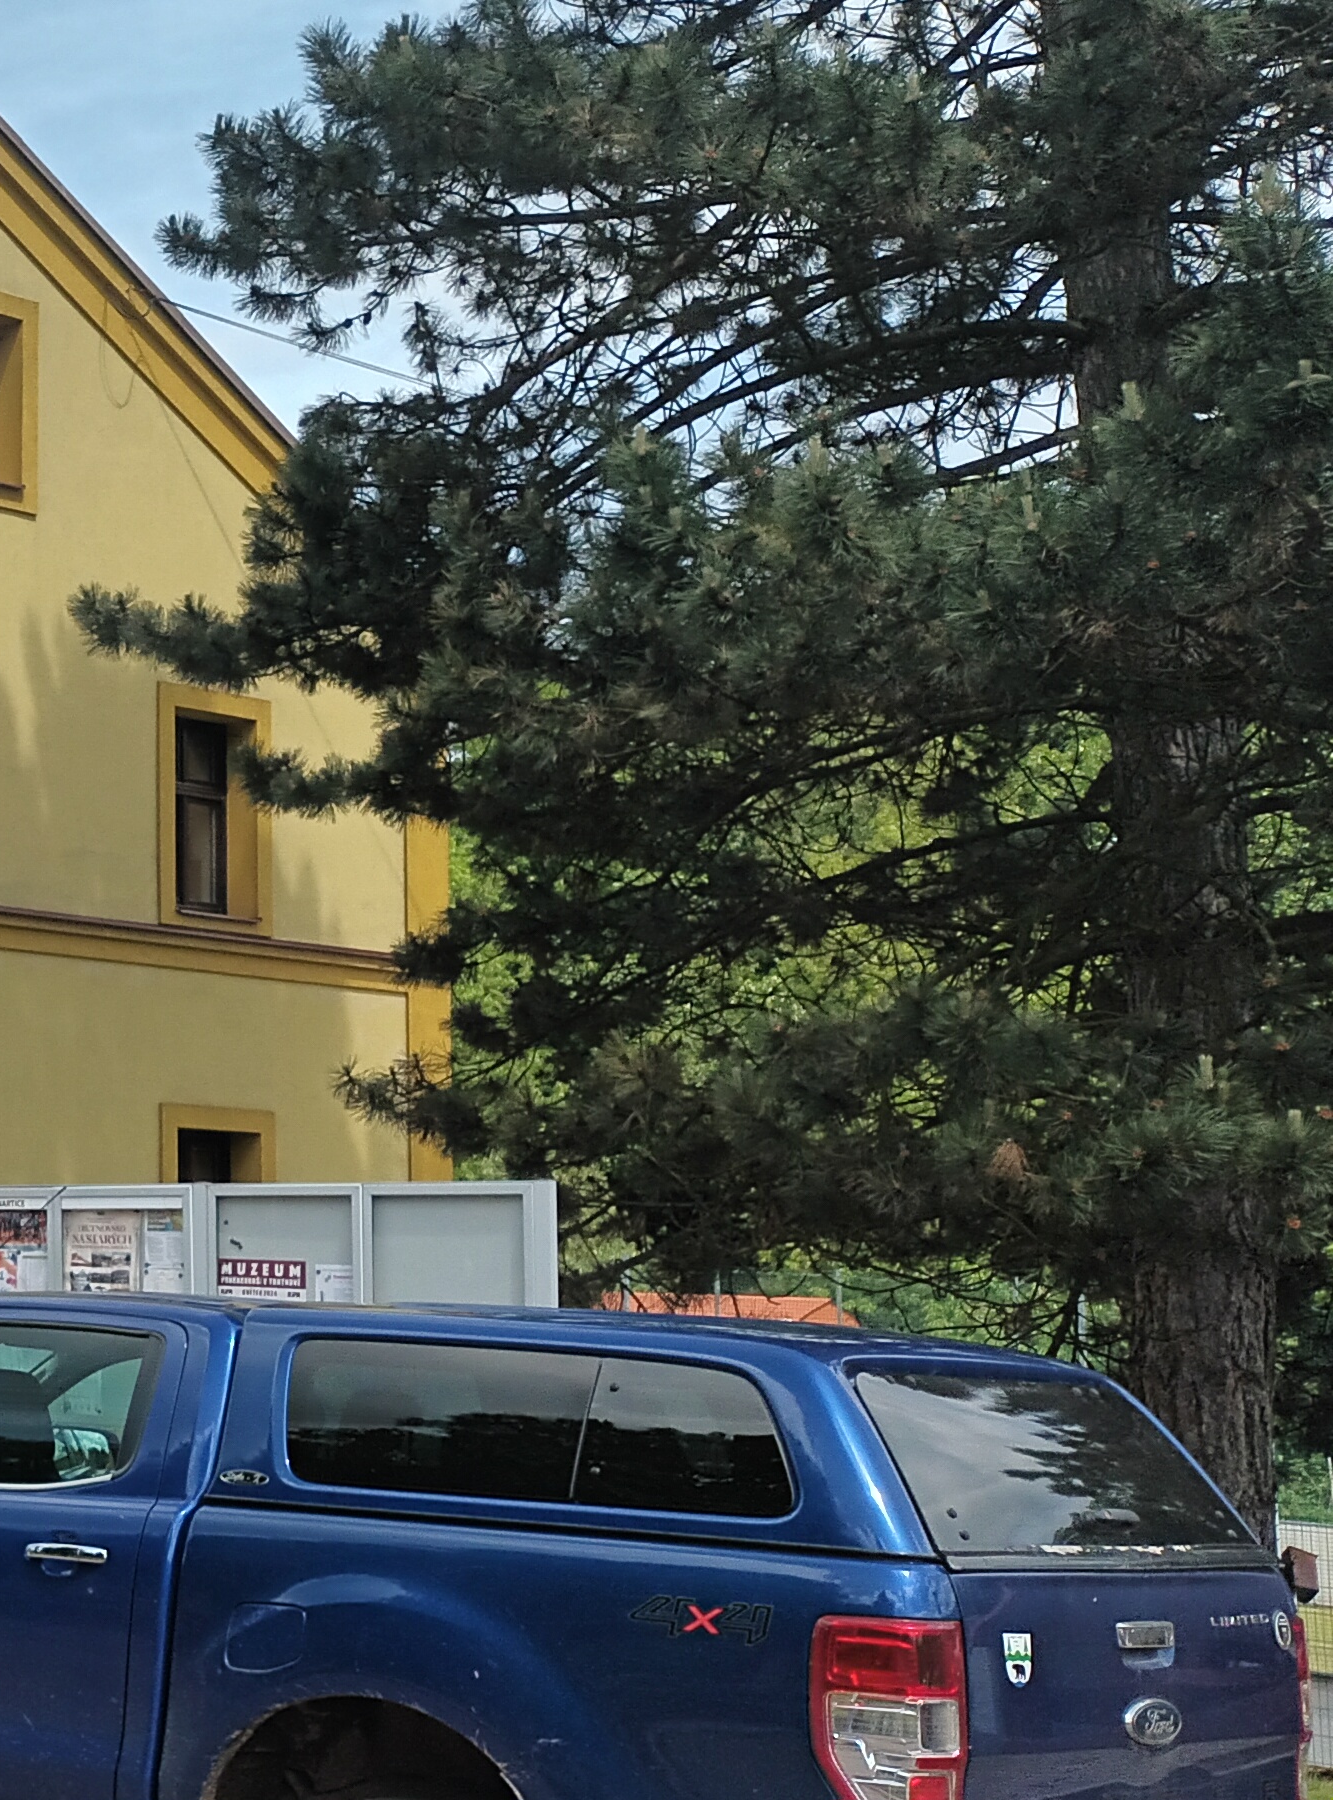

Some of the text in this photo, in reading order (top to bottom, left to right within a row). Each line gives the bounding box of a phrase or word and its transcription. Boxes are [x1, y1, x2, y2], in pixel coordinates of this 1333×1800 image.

[220, 1261, 302, 1278] MUZEUM
[1209, 1613, 1270, 1628] LIMITED
[1144, 1707, 1175, 1735] Ford
